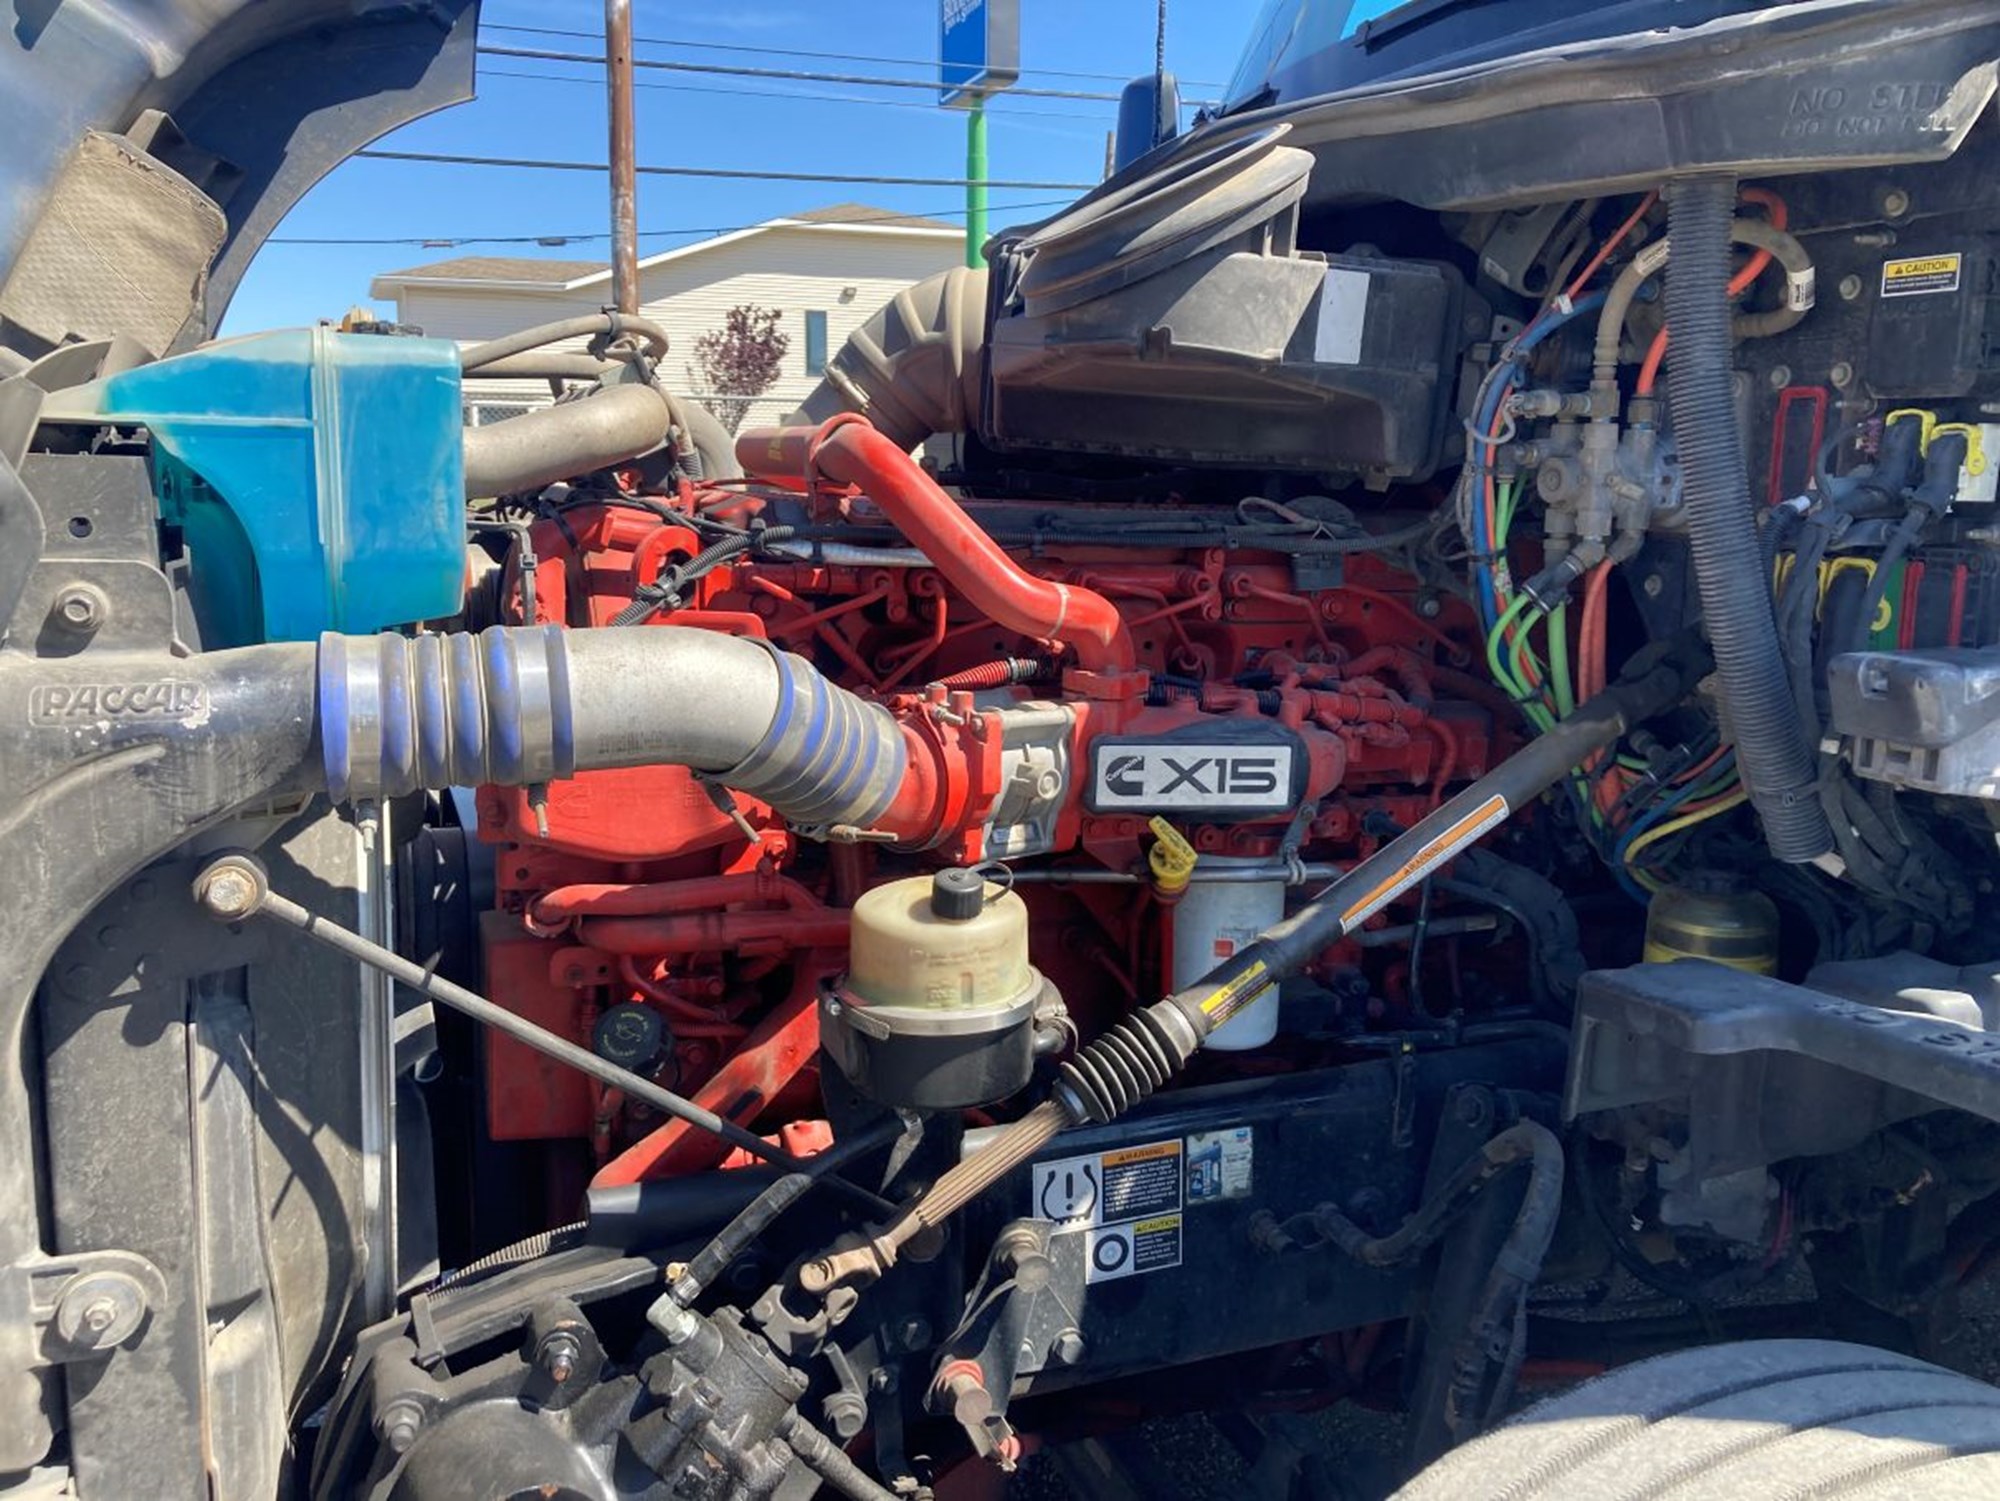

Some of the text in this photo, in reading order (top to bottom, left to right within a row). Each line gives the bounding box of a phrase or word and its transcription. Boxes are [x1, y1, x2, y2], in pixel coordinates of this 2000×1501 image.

[1789, 86, 1847, 115] NO
[1905, 260, 1949, 273] CAUTION
[42, 682, 202, 717] PACCAR
[1157, 757, 1277, 795] X15
[1406, 842, 1445, 870] WARNING
[1125, 1147, 1165, 1160] WARNING
[1141, 1216, 1180, 1230] CAUTION
